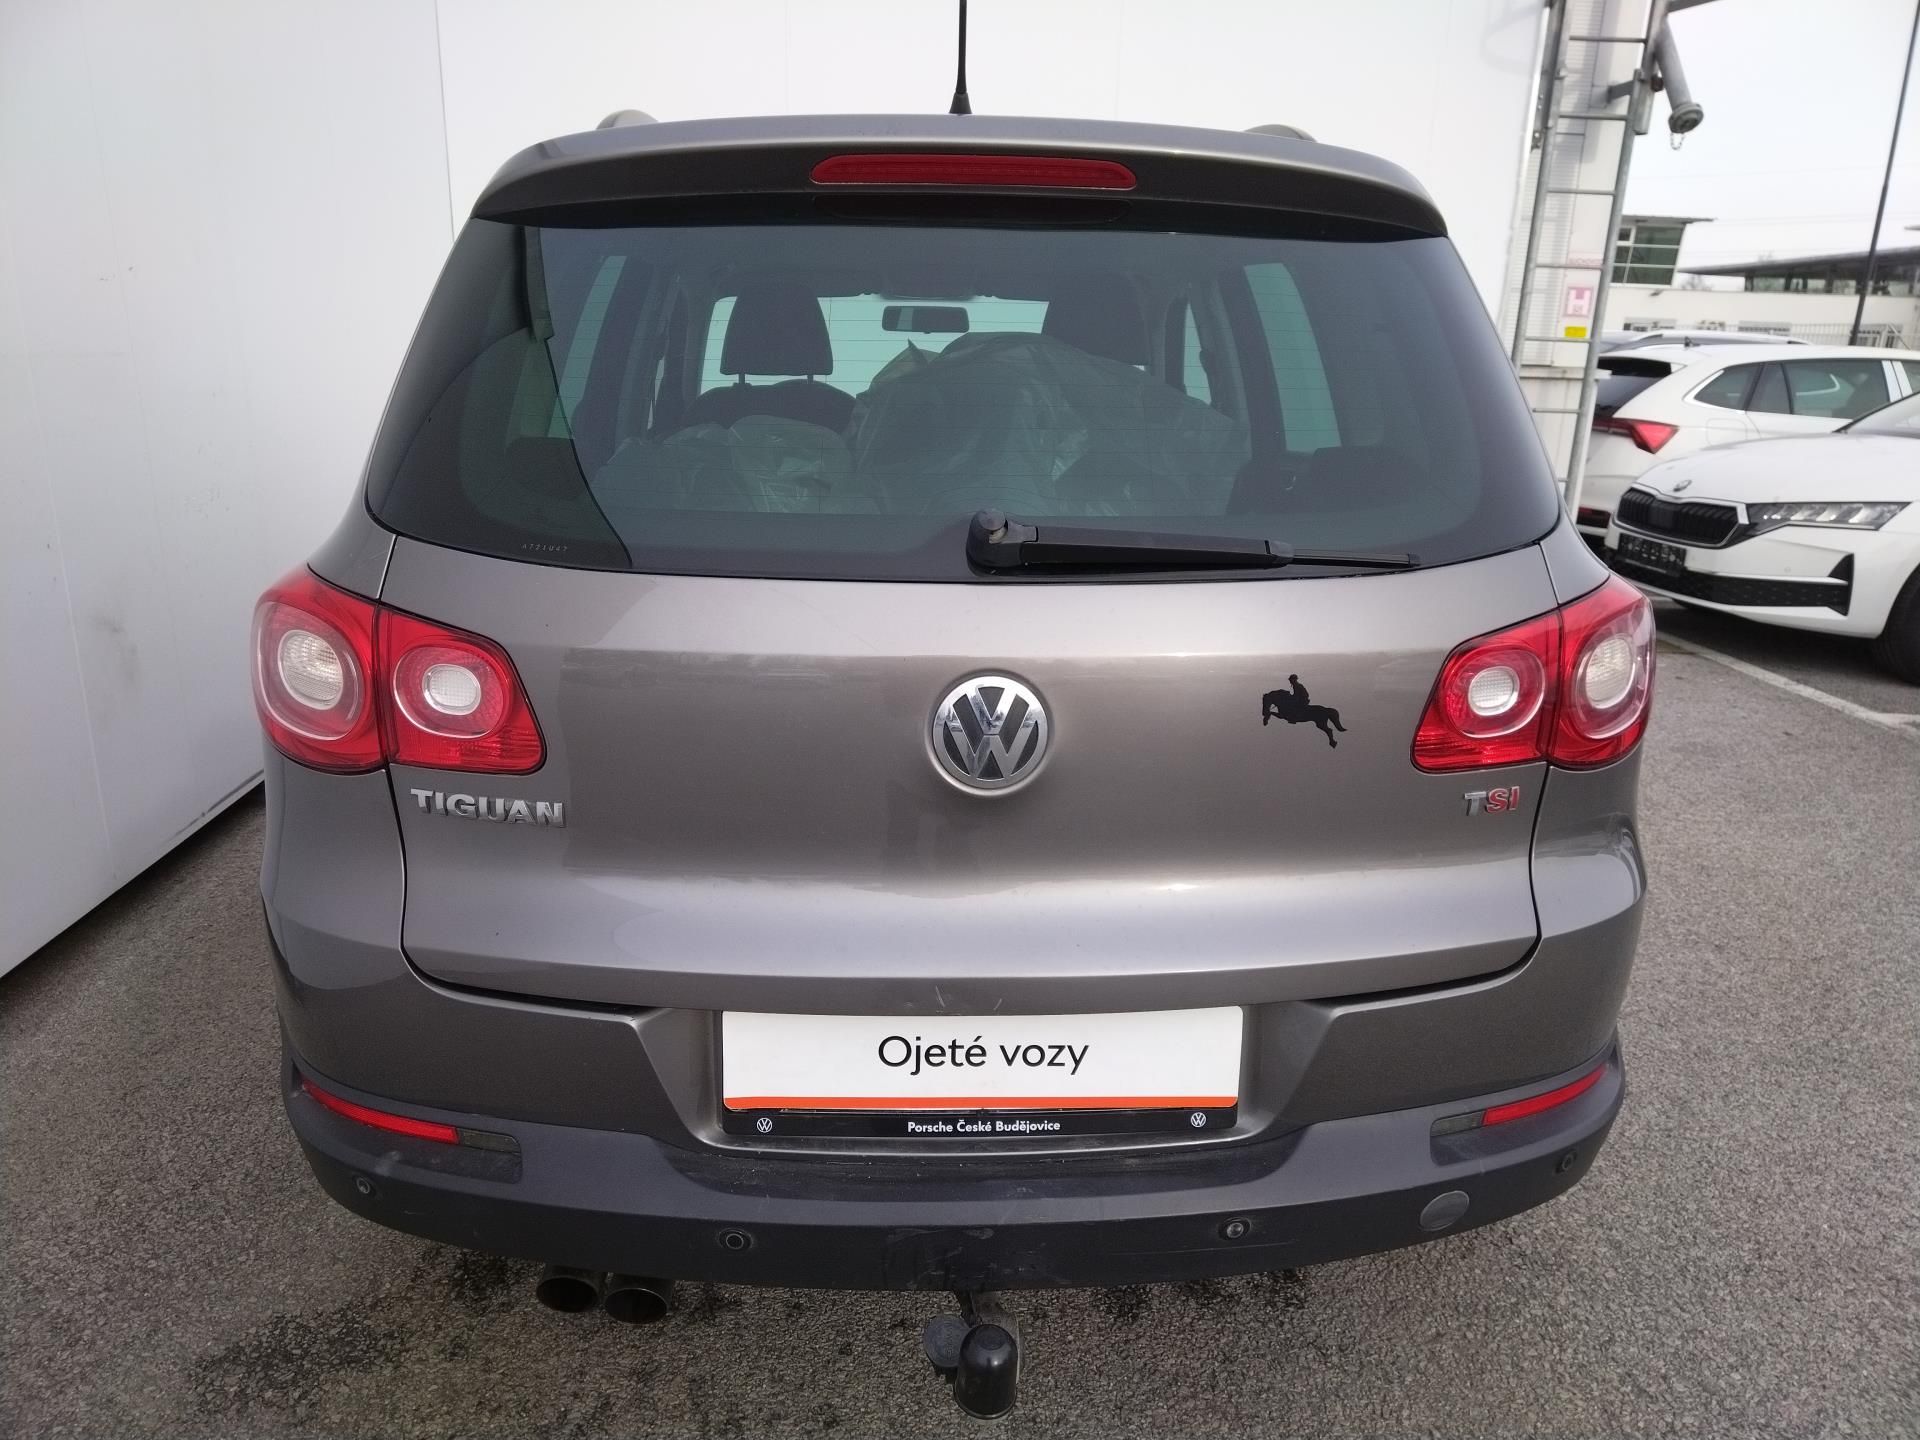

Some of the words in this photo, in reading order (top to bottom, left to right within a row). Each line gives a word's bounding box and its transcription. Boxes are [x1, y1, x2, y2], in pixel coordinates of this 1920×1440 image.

[410, 788, 566, 829] TIGUAN
[1463, 785, 1521, 817] TSI
[878, 1035, 988, 1076] Ojeté
[999, 1044, 1090, 1076] vozy
[907, 1121, 954, 1133] Porsche
[956, 1119, 993, 1132] České
[995, 1120, 1061, 1133] Budějovice
